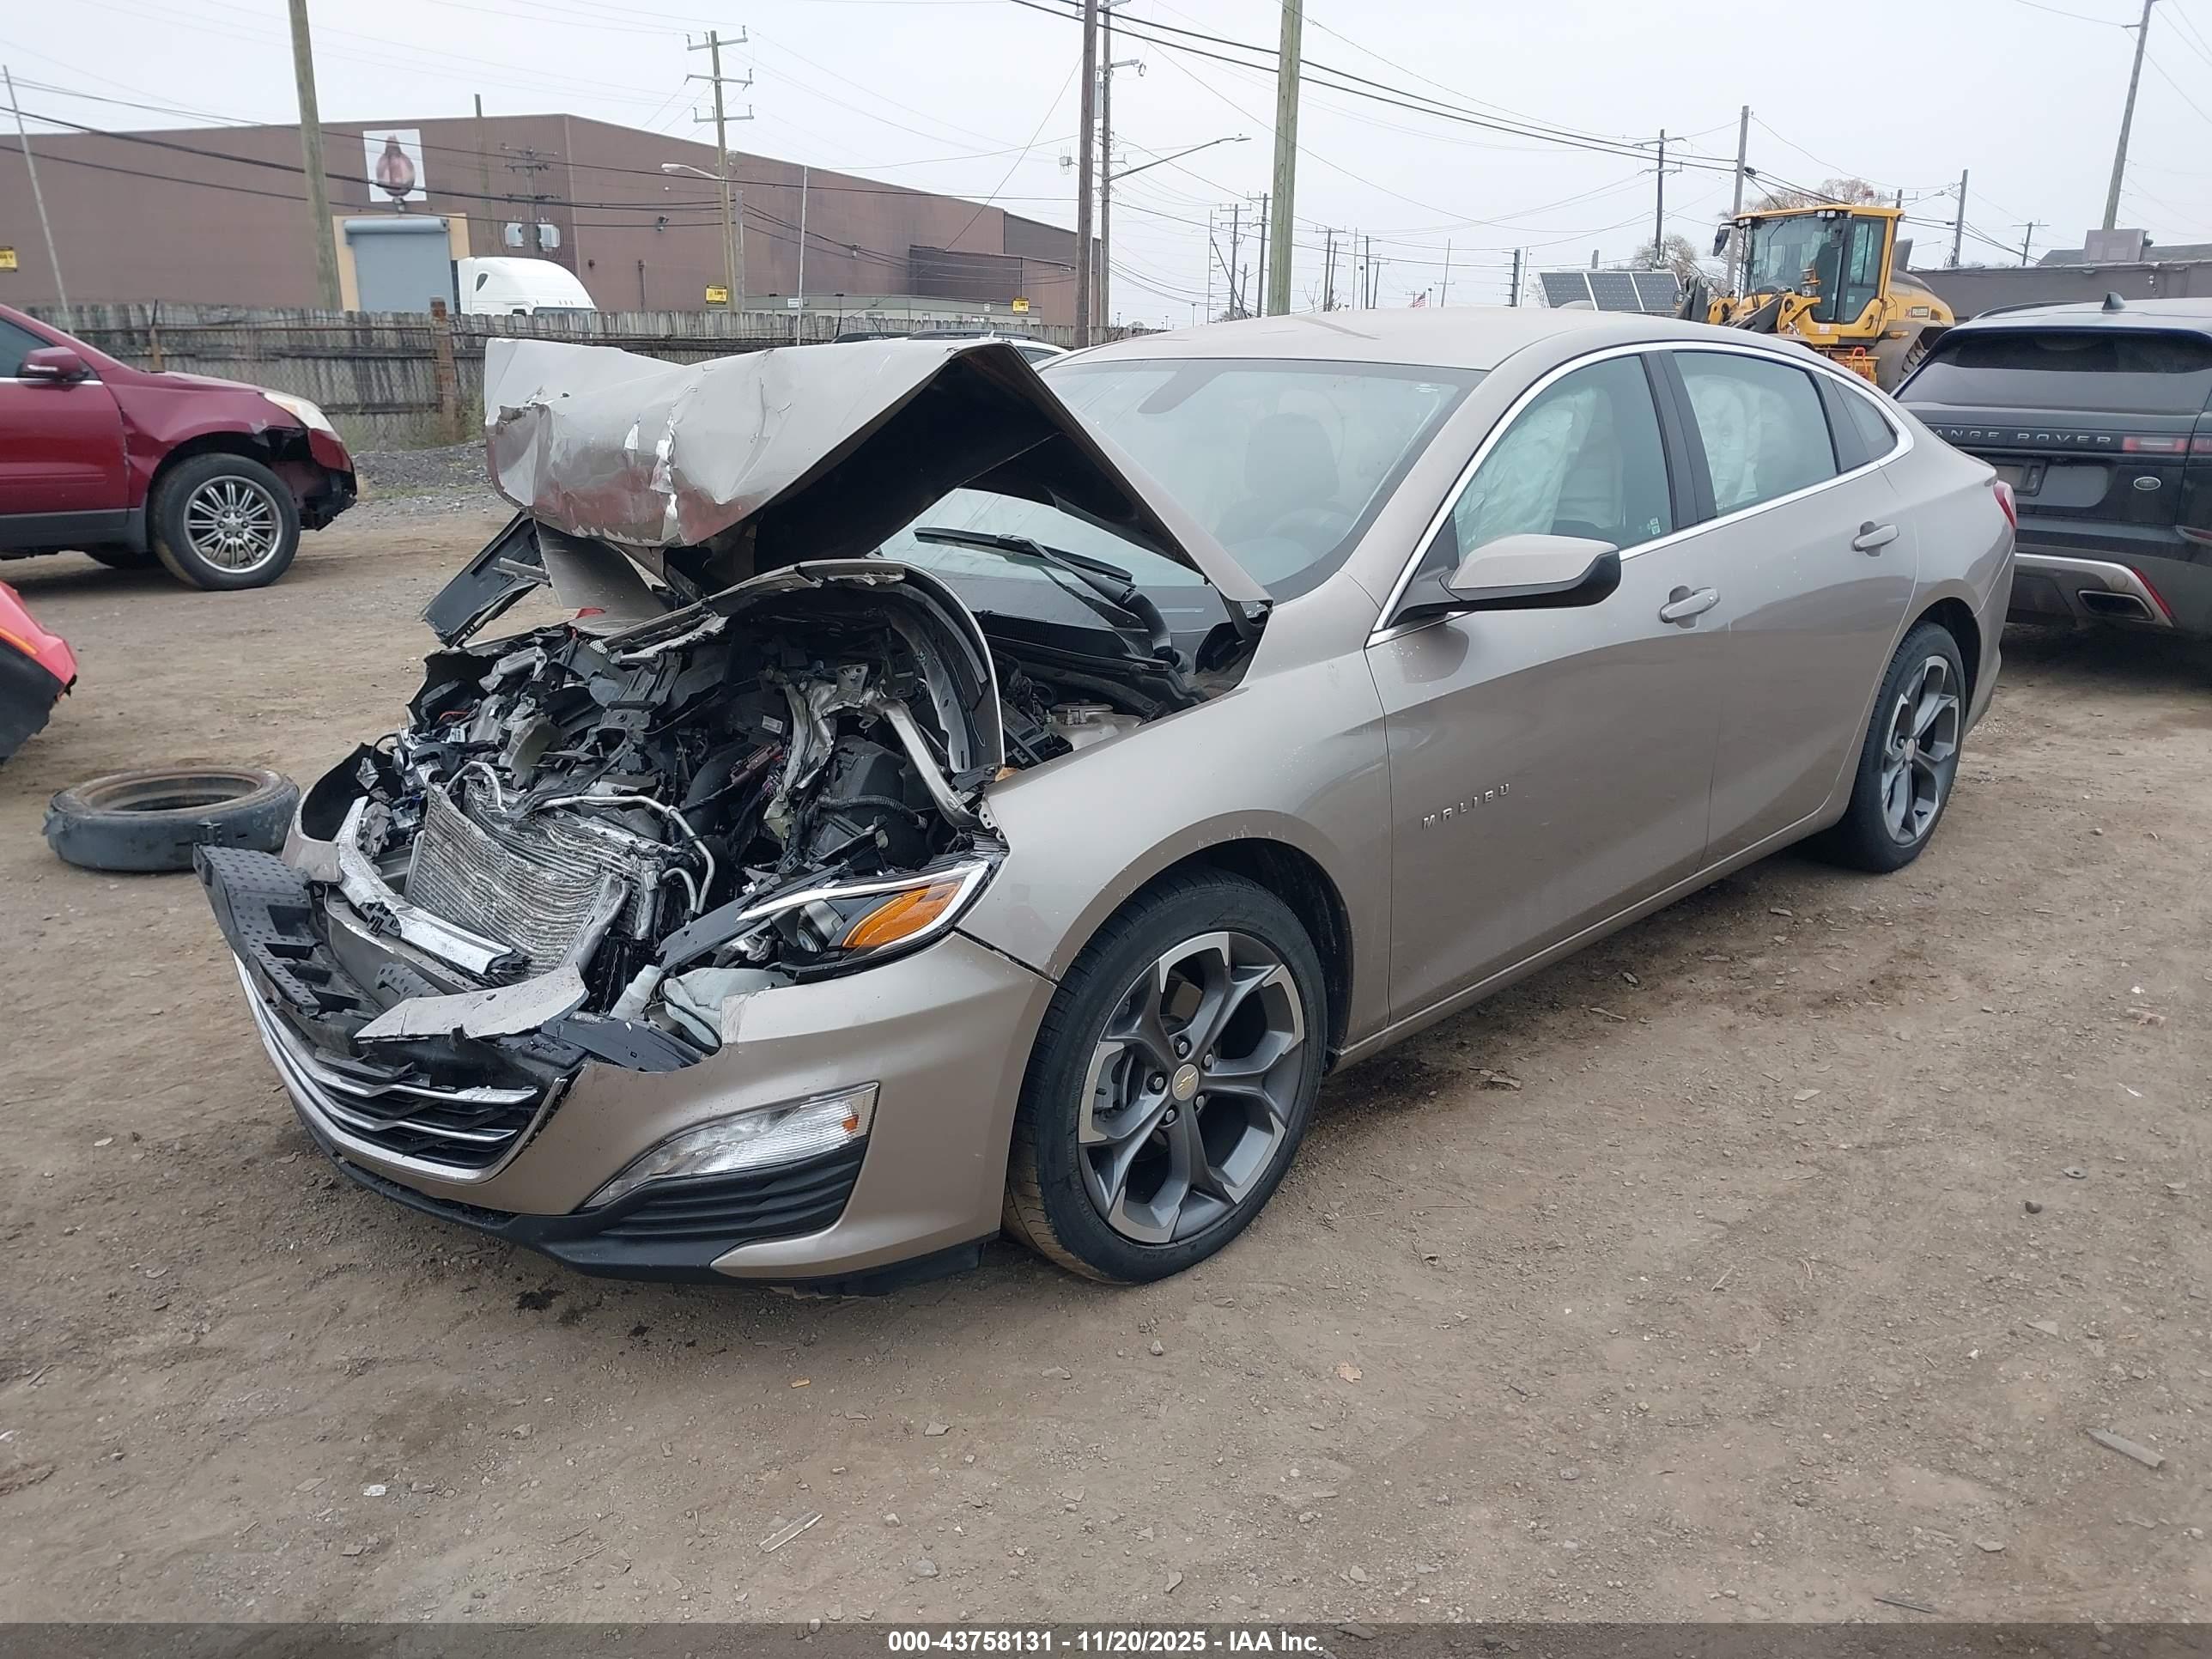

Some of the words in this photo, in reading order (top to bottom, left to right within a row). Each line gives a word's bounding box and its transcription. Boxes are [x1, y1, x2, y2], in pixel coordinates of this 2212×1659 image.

[1935, 429, 2000, 440] ANGE
[2017, 433, 2112, 444] ROVER
[1422, 783, 1510, 830] MALIBU
